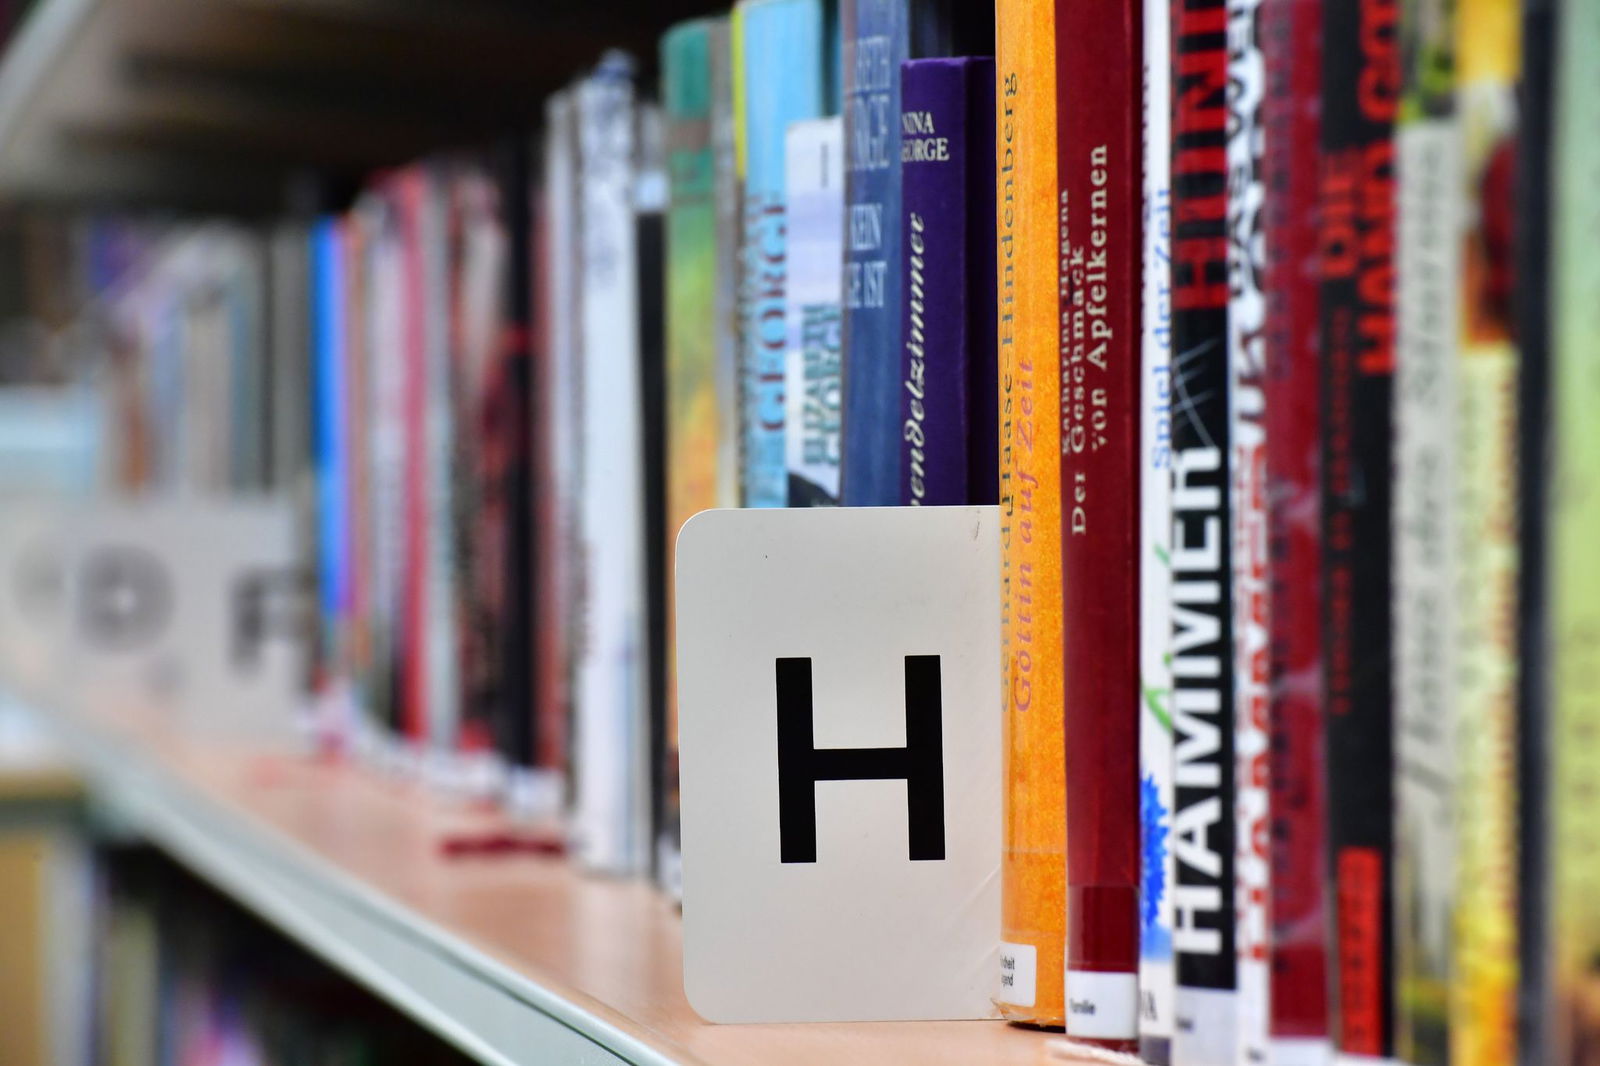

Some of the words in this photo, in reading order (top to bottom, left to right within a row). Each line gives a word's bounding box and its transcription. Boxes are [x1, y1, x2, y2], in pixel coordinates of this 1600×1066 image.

[1001, 73, 1017, 518] Haase-Hindenberg
[1086, 144, 1113, 370] Apfelkernen
[1153, 282, 1170, 350] der
[903, 212, 925, 506] endelzimmer
[1016, 358, 1035, 453] Zeit
[1060, 311, 1071, 455] Katharina
[1070, 246, 1085, 453] Geschmack
[1091, 388, 1107, 450] von
[1152, 364, 1171, 468] Spiel
[1019, 460, 1039, 545] auf
[1071, 472, 1086, 536] Der
[1013, 562, 1033, 712] Göttin
[1170, 447, 1222, 953] HAMMER
[776, 655, 946, 864] H
